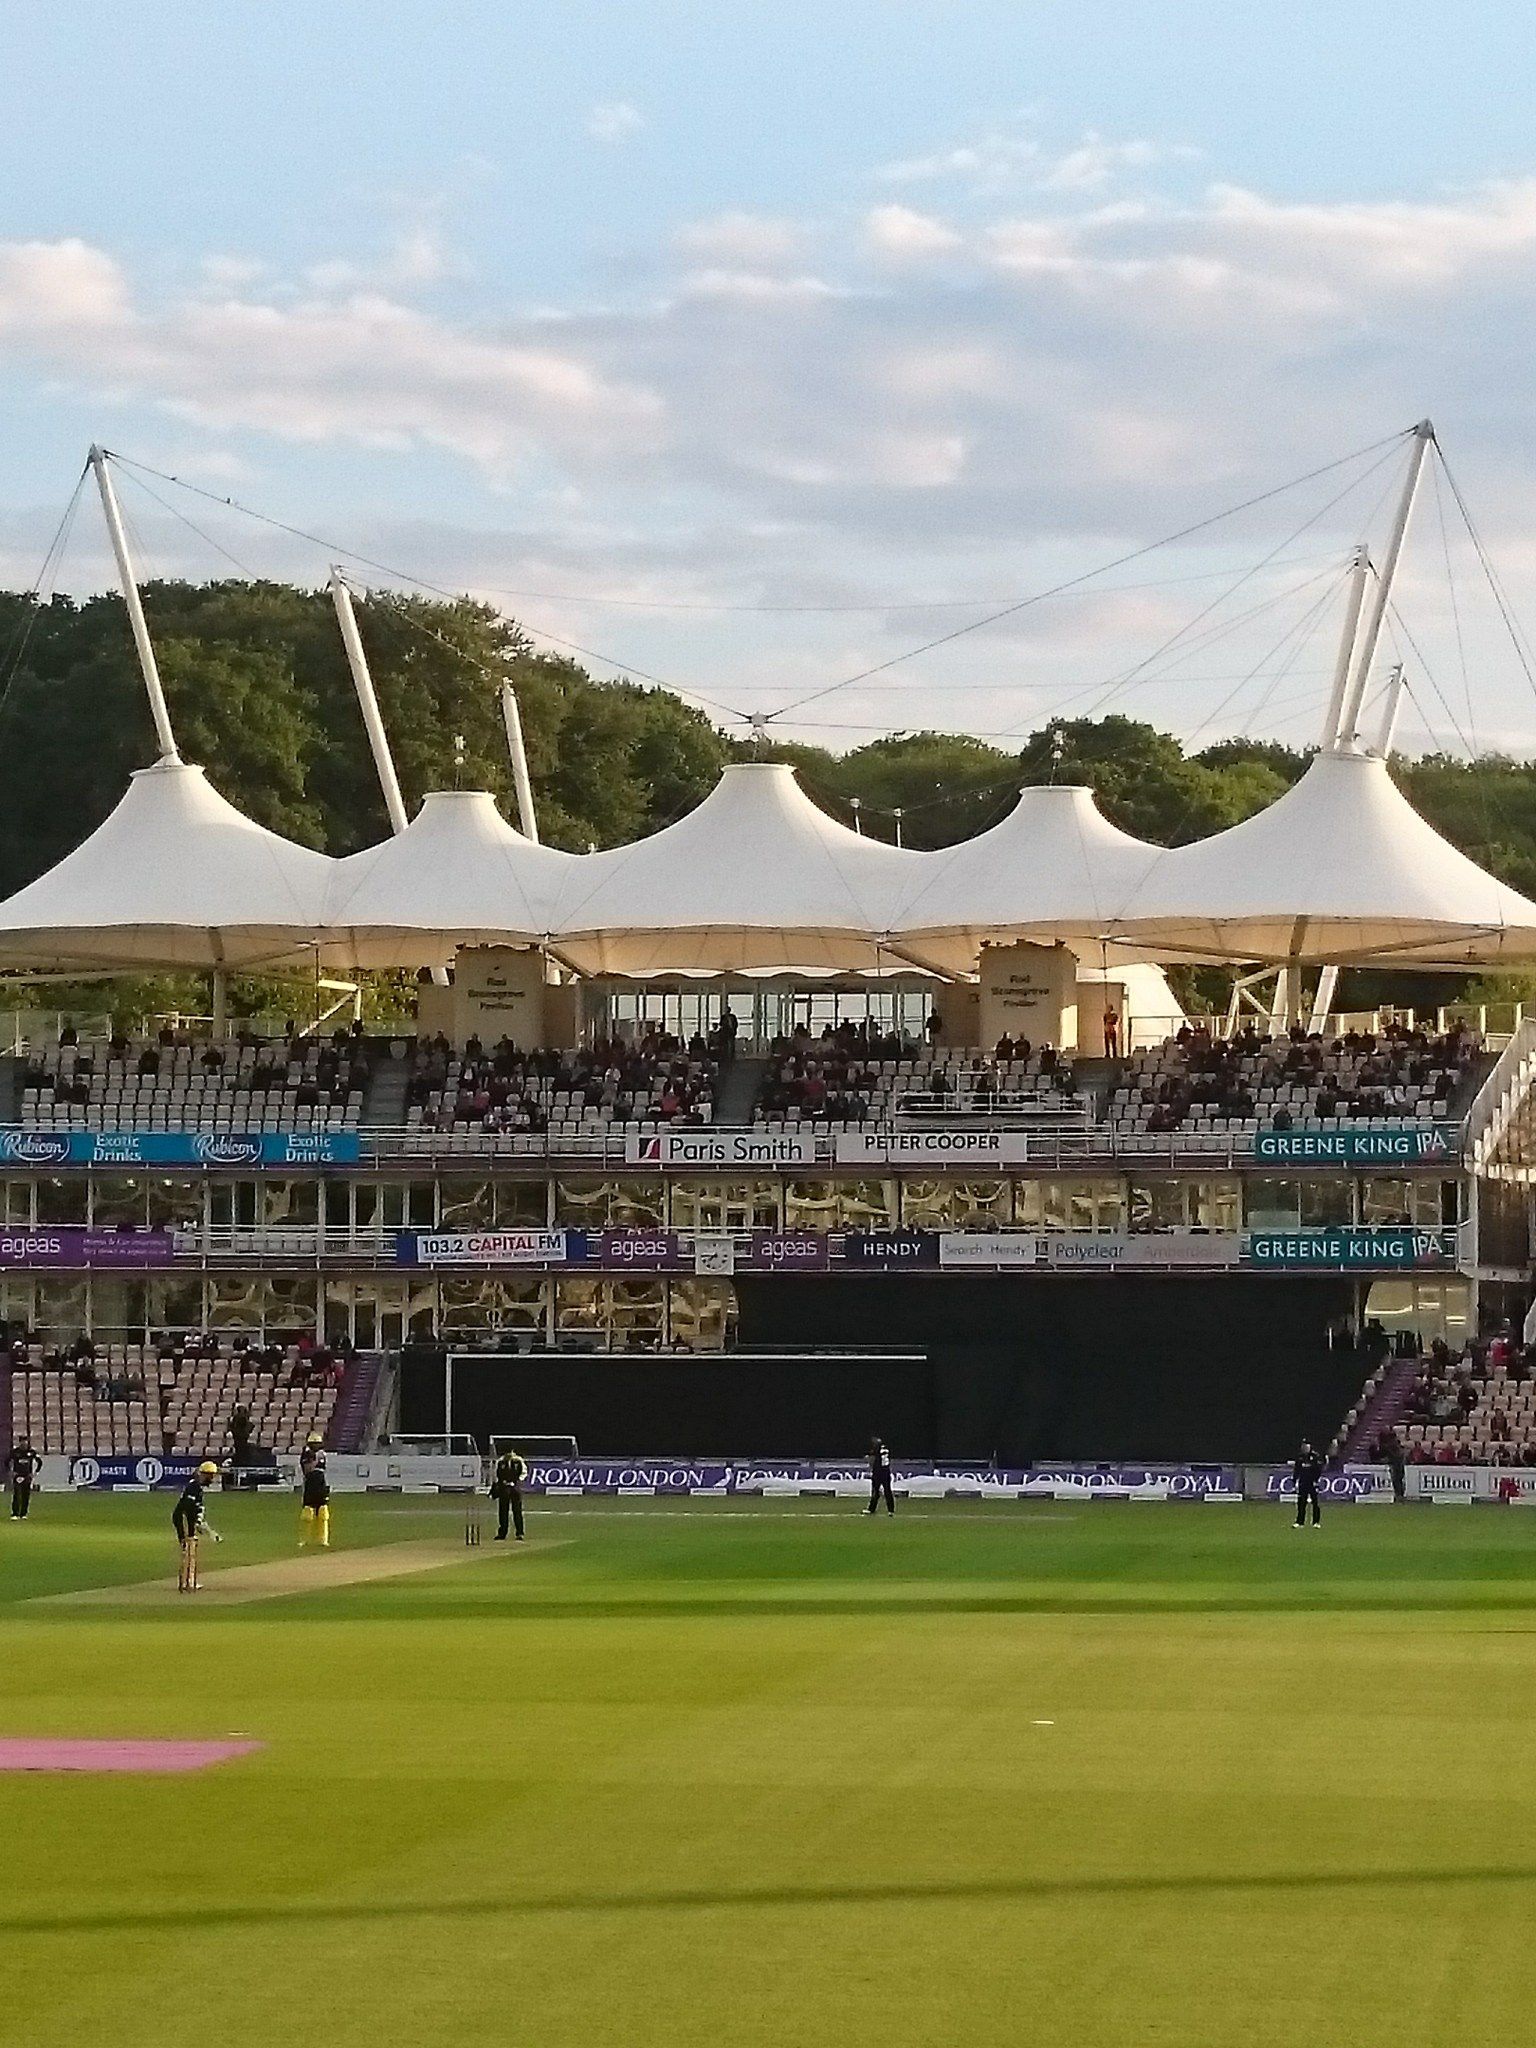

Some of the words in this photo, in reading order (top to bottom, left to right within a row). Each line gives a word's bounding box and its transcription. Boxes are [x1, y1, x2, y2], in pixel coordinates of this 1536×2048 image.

[4, 1134, 65, 1156] Rubicon
[96, 1133, 139, 1147] Exotic
[197, 1134, 257, 1157] Rubicon
[288, 1133, 331, 1147] Exotic
[669, 1137, 726, 1160] Paris
[733, 1137, 803, 1160] Smith
[864, 1136, 923, 1150] PETER
[925, 1135, 1000, 1150] COOPER
[1261, 1138, 1346, 1155] GREENE
[1354, 1138, 1409, 1154] KING
[1416, 1130, 1447, 1153] IPA
[93, 1148, 142, 1161] Drinks
[1, 1238, 61, 1259] ageas
[422, 1239, 464, 1254] 103.2
[468, 1236, 535, 1251] CAPITAL
[538, 1235, 562, 1249] FM
[611, 1240, 667, 1261] ageas
[761, 1240, 818, 1261] ageas
[863, 1243, 922, 1256] HENDY
[1055, 1242, 1125, 1260] Polyclear
[1255, 1241, 1341, 1258] GREENE
[1349, 1241, 1404, 1258] KING
[1412, 1236, 1443, 1256] IPA
[164, 1466, 197, 1475] TRANSP
[530, 1468, 600, 1486] ROYAL
[605, 1469, 704, 1487] LONDON
[1267, 1476, 1368, 1493] LODON
[1423, 1475, 1471, 1490] Hilton
